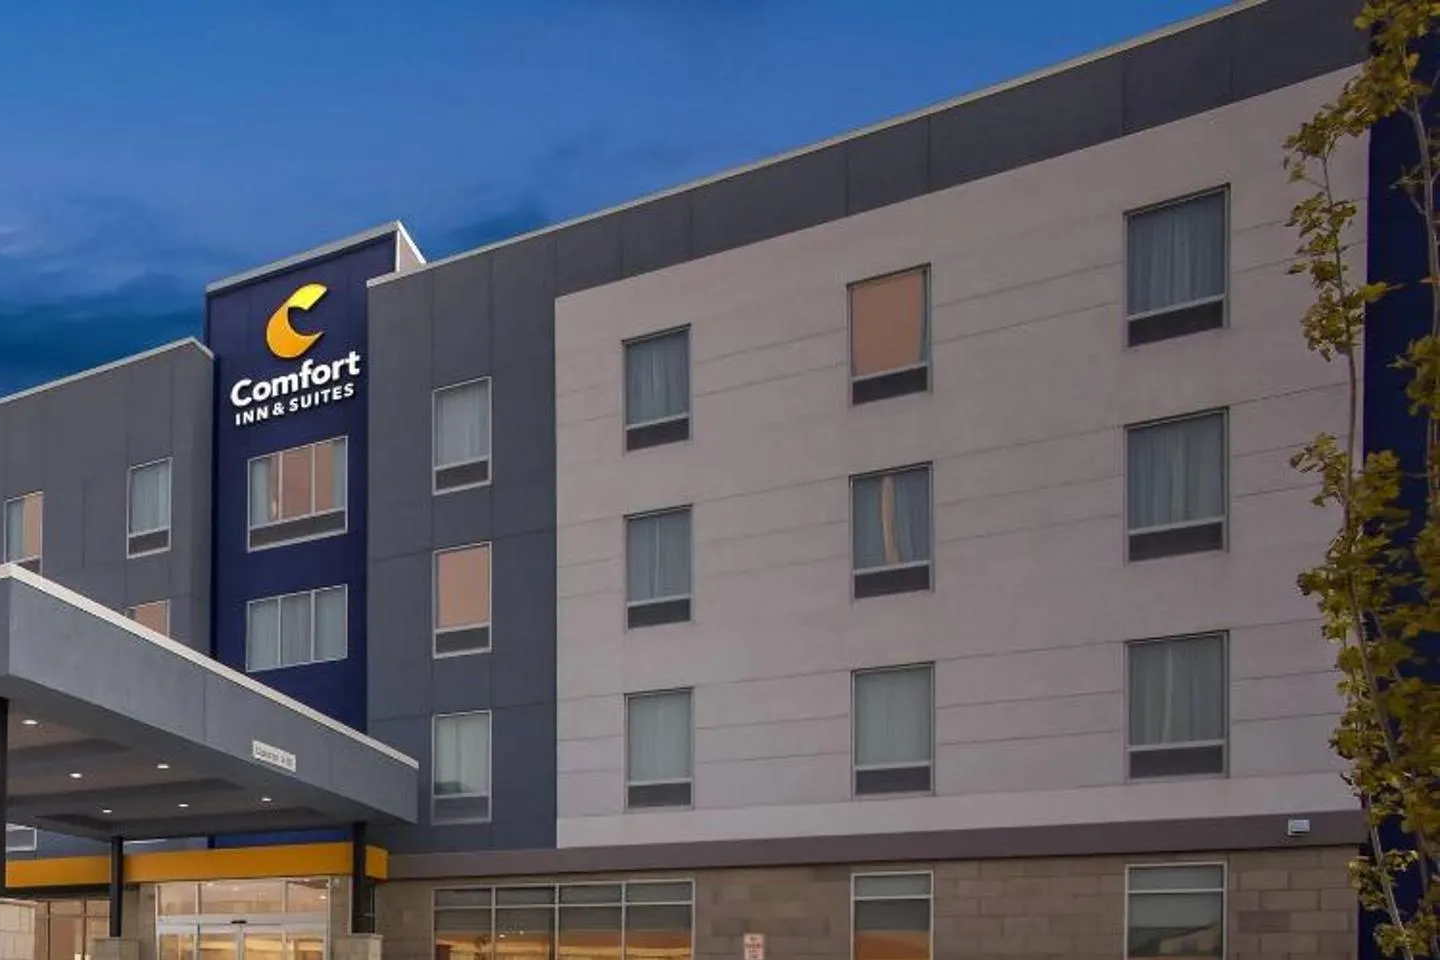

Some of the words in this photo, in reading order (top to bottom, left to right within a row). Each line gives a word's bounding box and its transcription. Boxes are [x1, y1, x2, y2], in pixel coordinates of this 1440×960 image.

[230, 350, 361, 407] Comfort
[235, 405, 269, 426] INN
[272, 402, 286, 416] &
[289, 382, 355, 413] SUITES
